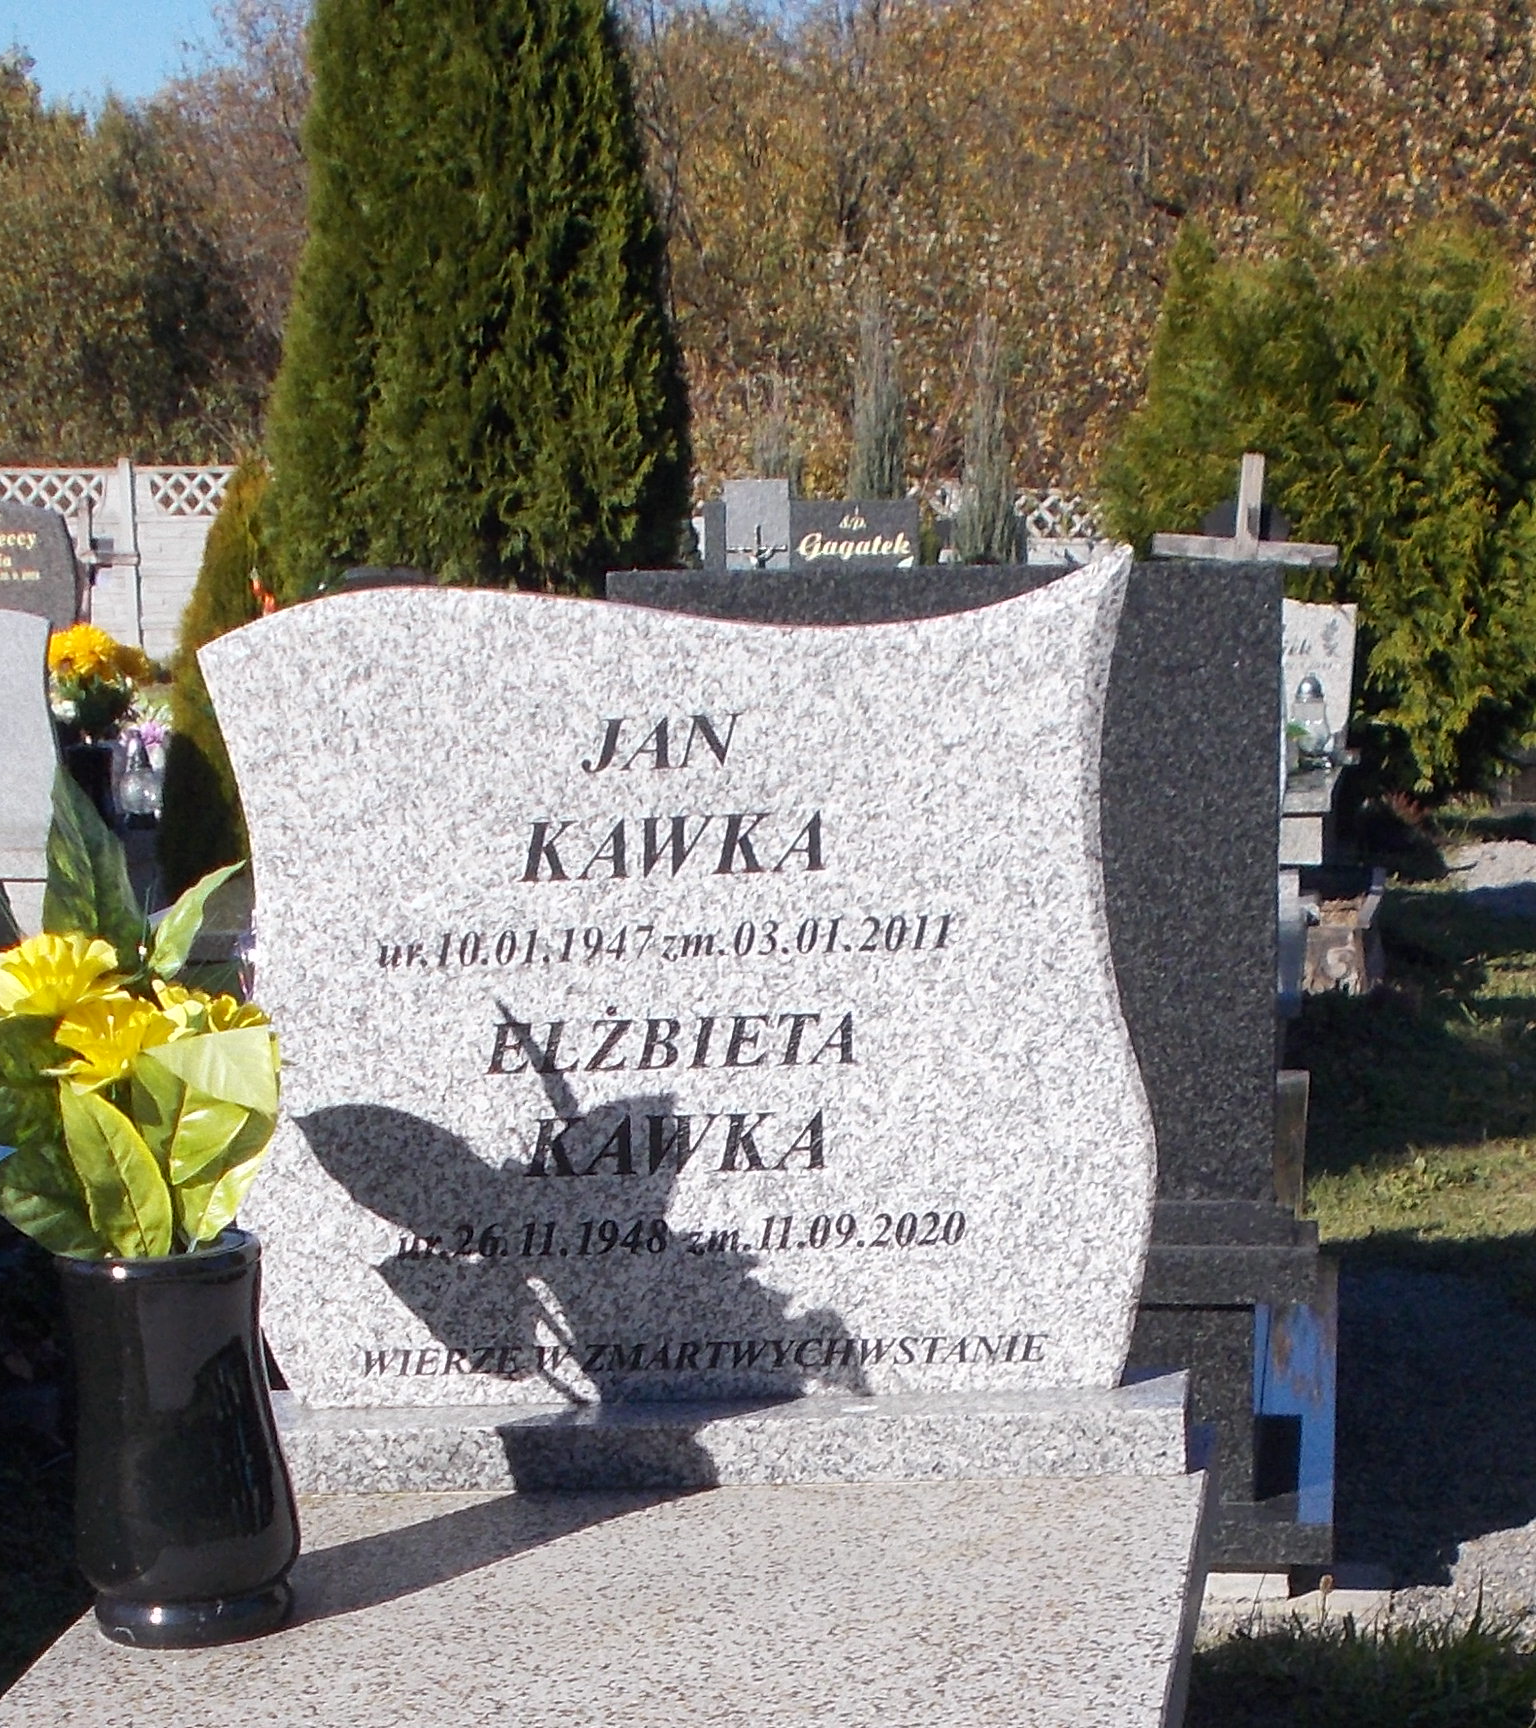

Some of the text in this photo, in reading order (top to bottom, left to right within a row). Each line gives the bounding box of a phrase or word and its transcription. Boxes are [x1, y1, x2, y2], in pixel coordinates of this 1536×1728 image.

[797, 531, 912, 562] Gagatek
[580, 712, 745, 775] JAN
[517, 809, 828, 883] KAWKA
[484, 1004, 860, 1076] ELŻBIETA
[522, 1107, 828, 1179] KAWKA
[533, 1346, 573, 1373] W
[582, 1333, 1052, 1374] ZMARTWYCHWSTANIE
